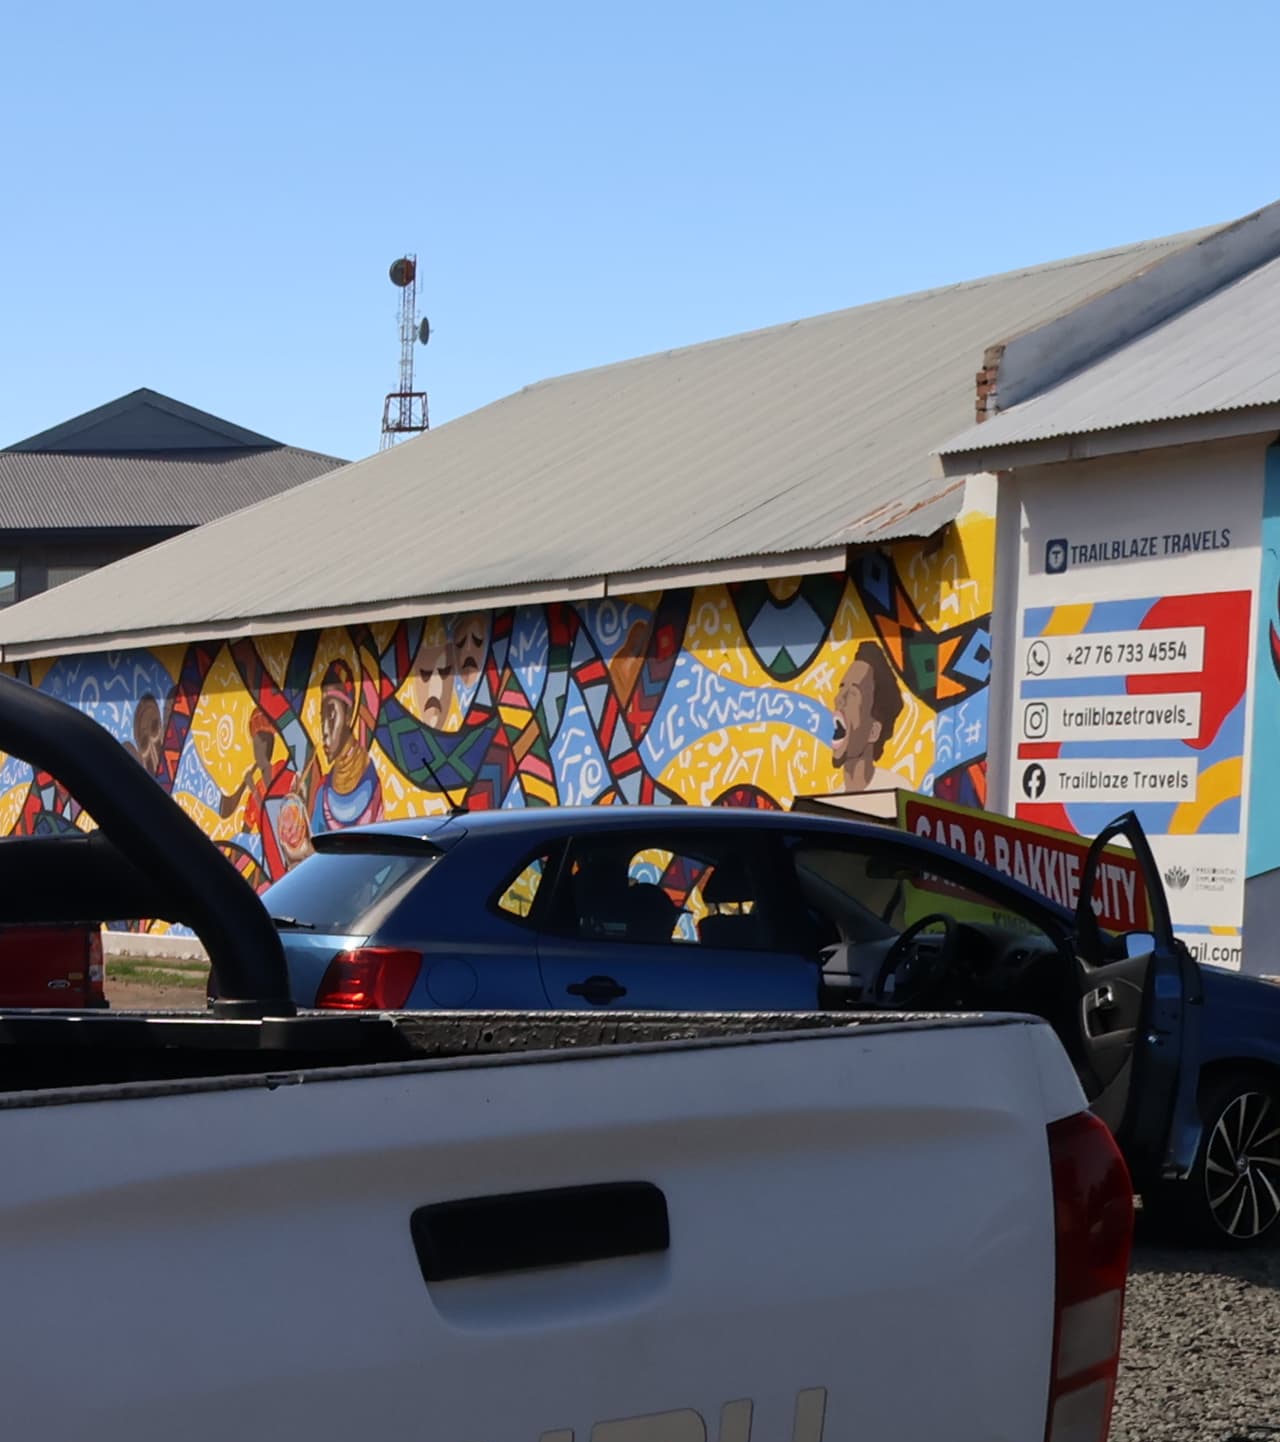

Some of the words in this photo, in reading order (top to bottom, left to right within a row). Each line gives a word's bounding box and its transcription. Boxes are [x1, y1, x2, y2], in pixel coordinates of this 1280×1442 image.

[1071, 536, 1158, 565] TRAILBLAZE
[1162, 528, 1231, 555] TRAVELS
[1066, 646, 1091, 665] +27
[1096, 644, 1113, 664] 76
[1117, 643, 1144, 663] 733
[1148, 641, 1187, 662] 4554
[1062, 704, 1193, 727] trailblazetravels_
[1059, 771, 1129, 789] Trailblaze
[1133, 770, 1189, 789] Travels
[993, 834, 1081, 912] BAKKIE
[1090, 862, 1137, 926] CITY
